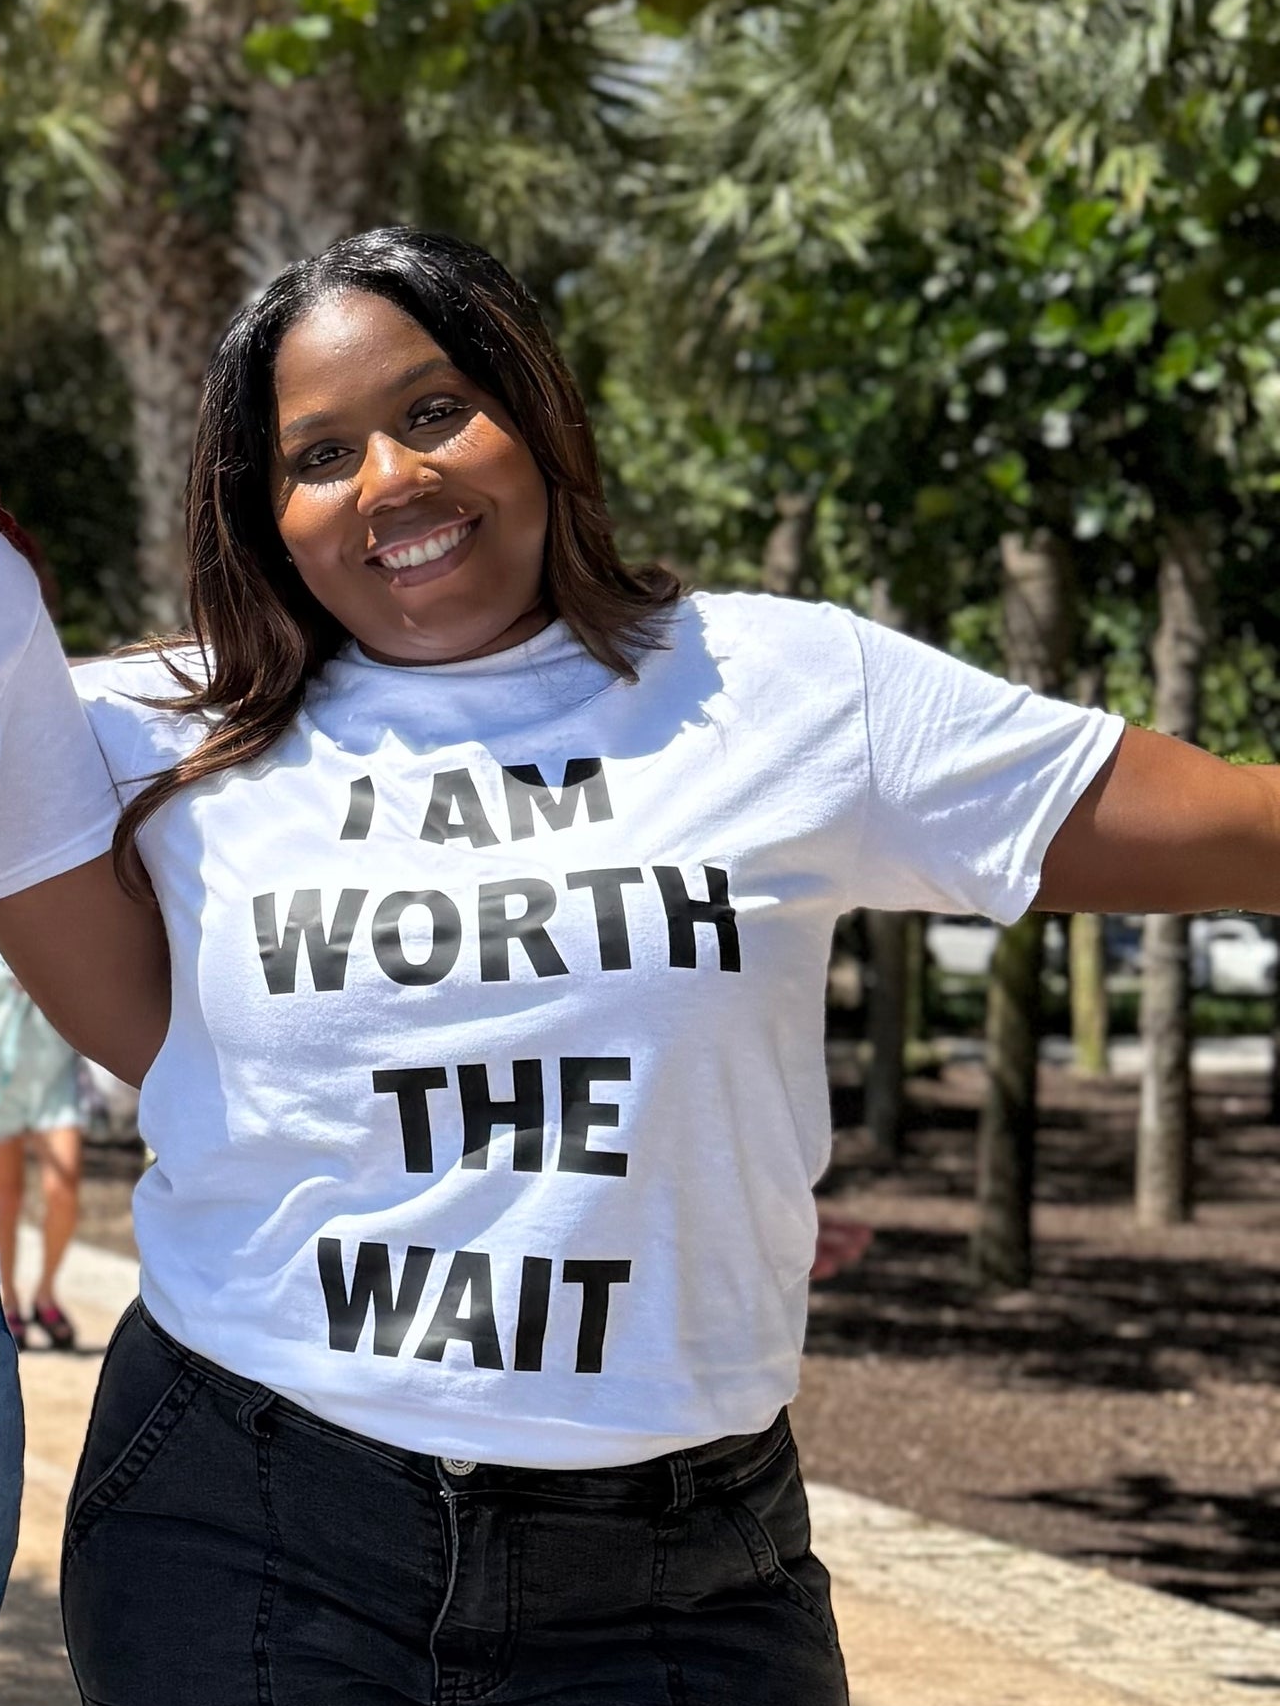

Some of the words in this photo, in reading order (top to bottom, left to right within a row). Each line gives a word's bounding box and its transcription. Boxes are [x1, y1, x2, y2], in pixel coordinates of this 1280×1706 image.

[340, 775, 375, 841] I
[419, 757, 614, 849] AM
[252, 865, 742, 995] WORTH
[372, 1057, 632, 1177] THE
[317, 1237, 632, 1374] WAIT
